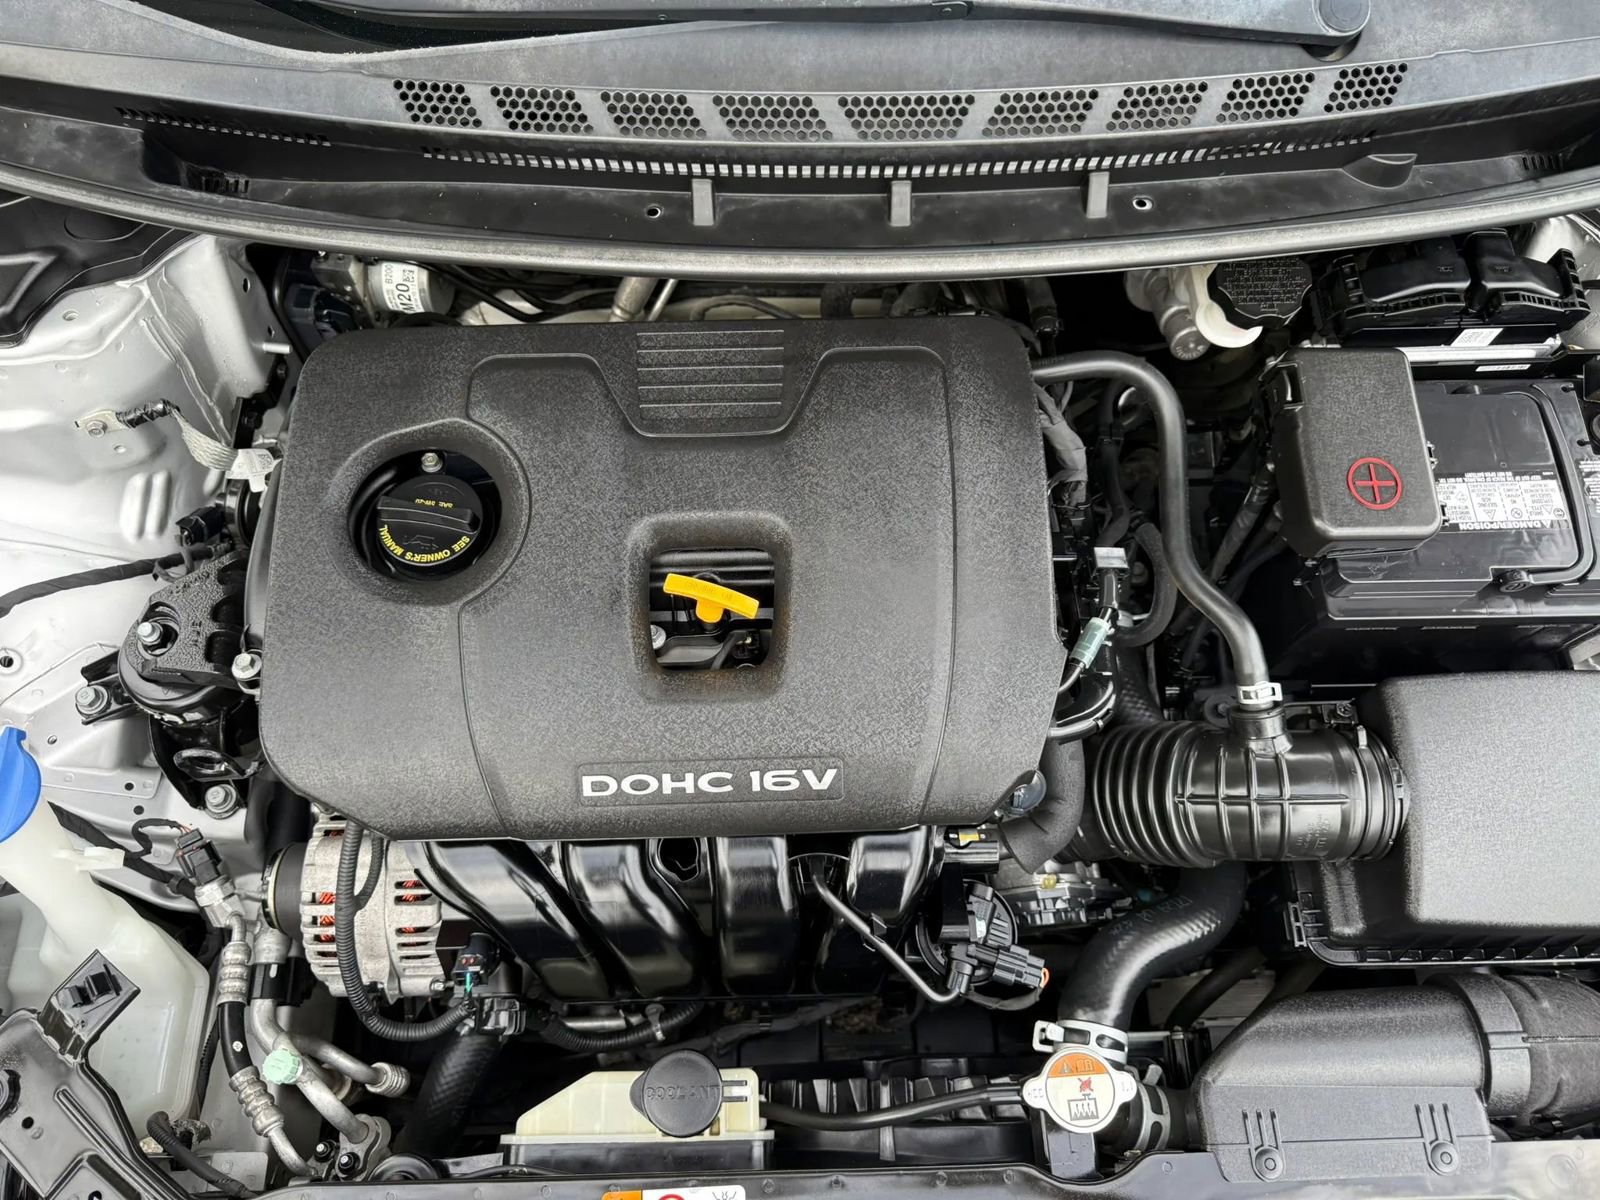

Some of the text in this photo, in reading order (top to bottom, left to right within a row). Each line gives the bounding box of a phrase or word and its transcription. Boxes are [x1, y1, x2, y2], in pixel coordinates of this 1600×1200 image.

[395, 283, 417, 312] M20
[377, 524, 471, 563] SEE OWNER'S MANUAL
[581, 768, 839, 797] DOHC 16V
[645, 1085, 720, 1101] COOLANT
